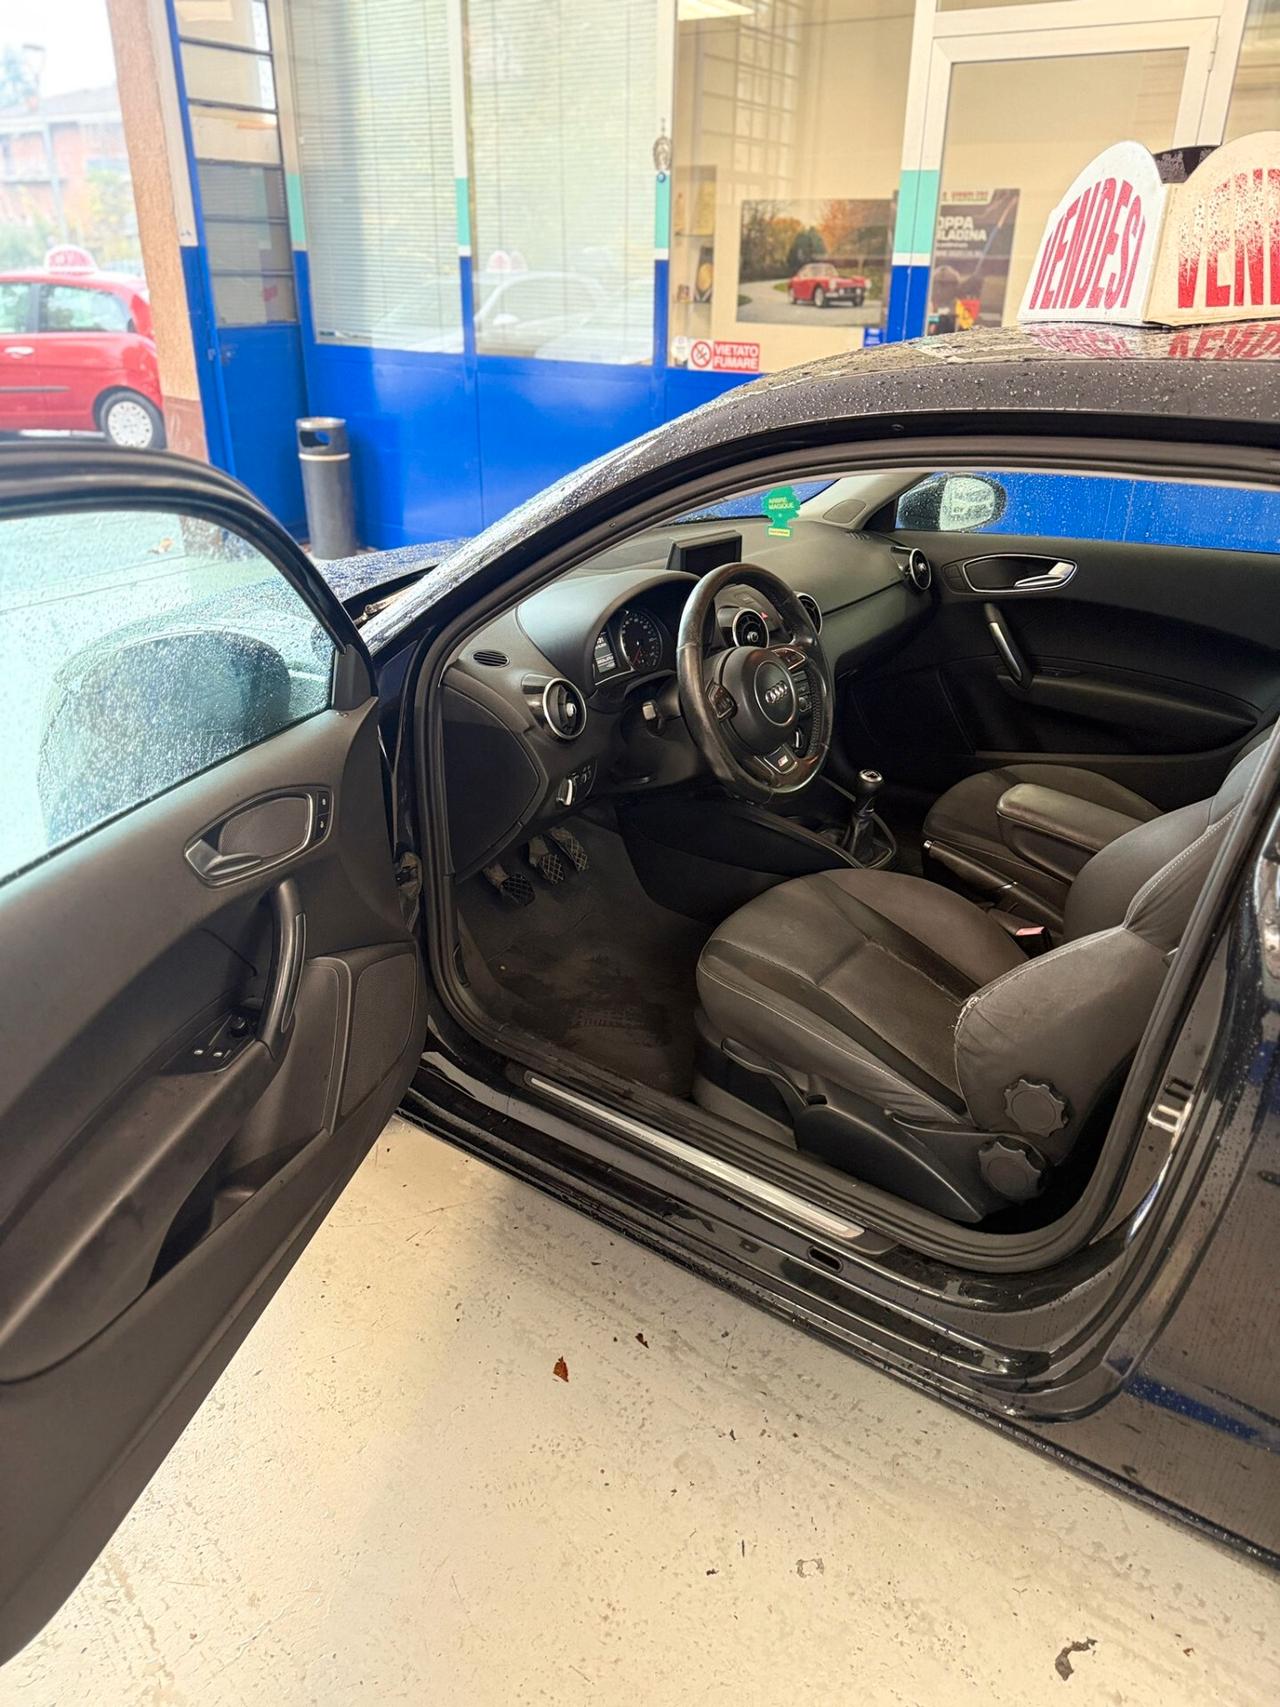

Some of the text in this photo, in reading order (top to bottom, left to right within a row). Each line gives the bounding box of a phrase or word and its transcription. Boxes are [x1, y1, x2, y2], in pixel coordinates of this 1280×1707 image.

[1029, 177, 1146, 310] VENDESI
[714, 343, 759, 357] VIETATO
[714, 356, 758, 369] FUMARE
